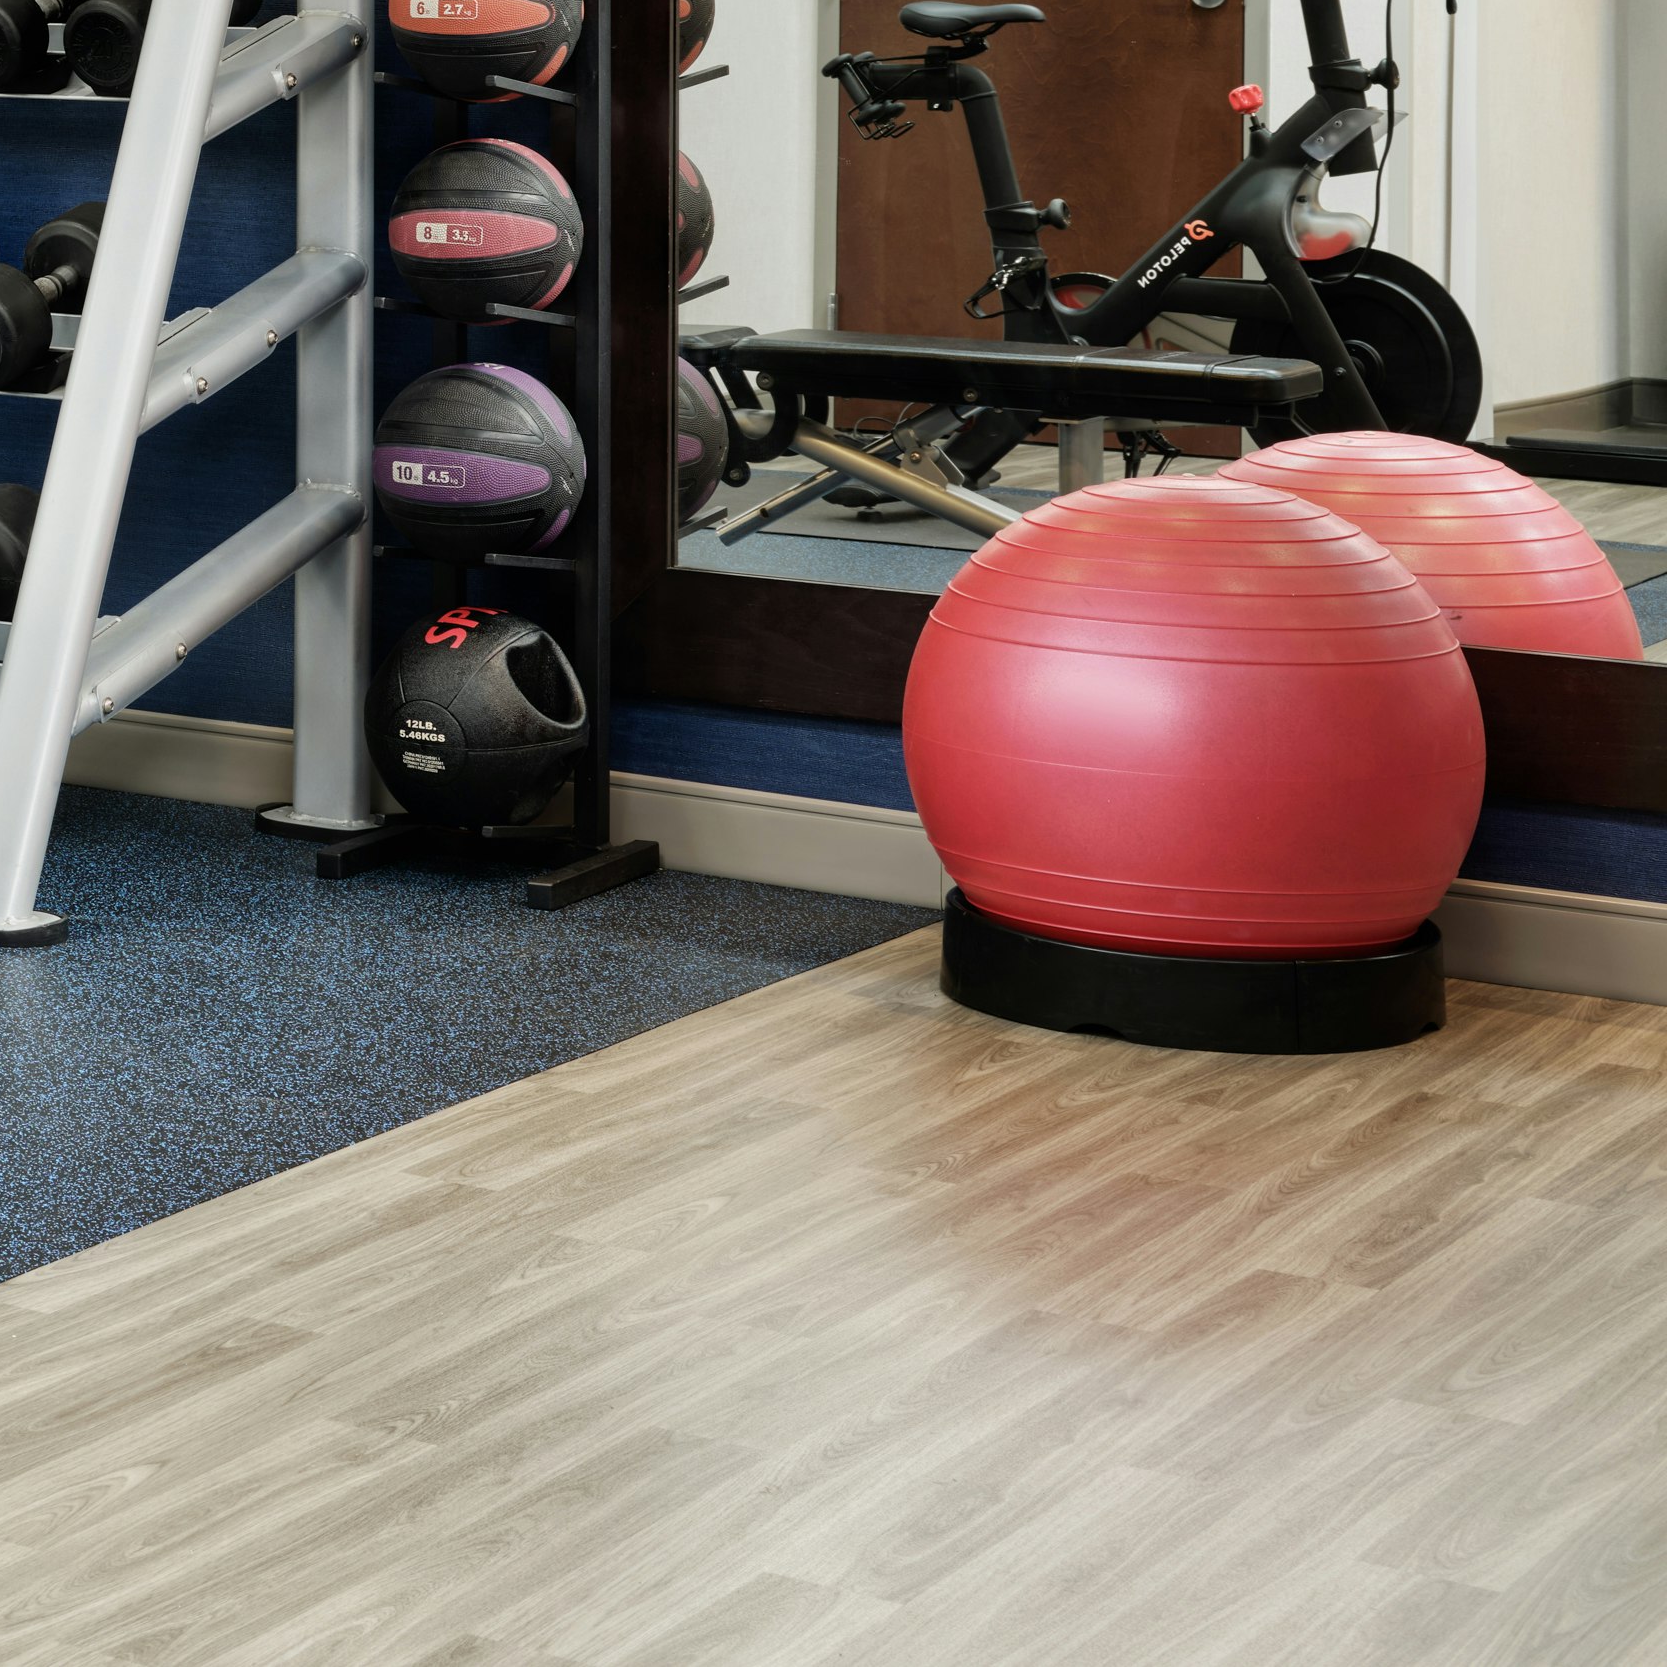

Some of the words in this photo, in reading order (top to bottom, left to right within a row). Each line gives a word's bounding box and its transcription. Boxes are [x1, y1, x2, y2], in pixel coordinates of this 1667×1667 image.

[417, 1, 425, 15] 6
[424, 226, 432, 239] 8
[397, 465, 413, 481] 10
[425, 606, 509, 649] SP
[406, 719, 437, 731] 12LB.
[399, 729, 446, 743] 5.46KGS
